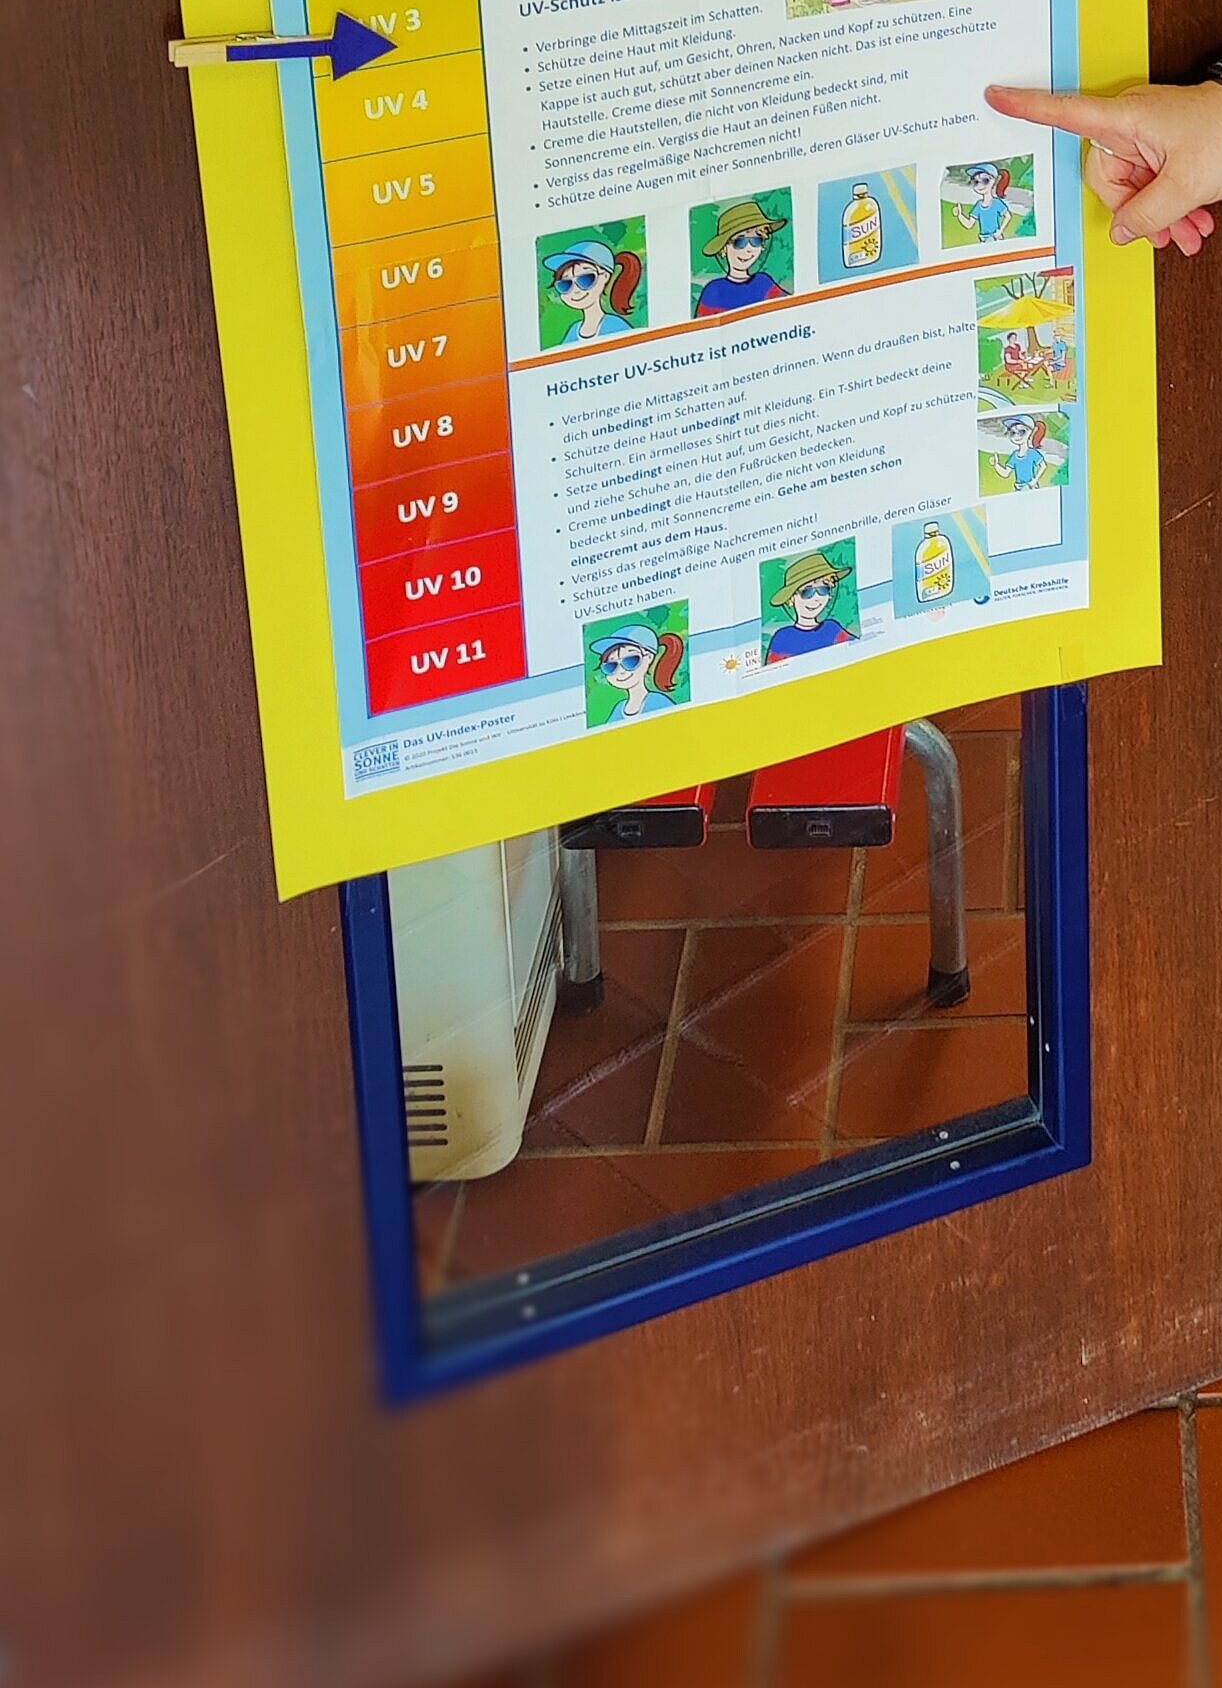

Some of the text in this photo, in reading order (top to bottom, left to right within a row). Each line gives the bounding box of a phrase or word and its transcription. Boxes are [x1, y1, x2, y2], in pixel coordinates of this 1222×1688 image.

[405, 8, 421, 31] 3
[535, 5, 762, 52] Verbringe die Mittagszeit im Schatten.
[537, 29, 735, 72] Schütze deine Haut mit Kleidung.
[538, 6, 972, 92] Setze einen Hut auf, um Gesicht, Ohren, Nacken und Kopf zu schützen. Eine
[365, 90, 428, 119] UV 4
[542, 70, 813, 131] Hautstelle. Creme diese mit Sonnencreme ein.
[544, 94, 880, 169] Sonnencreme ein. Vergiss die Haut an deinen Füßen nicht.
[545, 126, 800, 188] Vergiss das regelmäßige Nachcremen nicht!
[372, 173, 435, 204] UV 5
[851, 216, 877, 239] SUN
[380, 258, 444, 289] UV 6
[387, 336, 448, 368] UV 7
[546, 324, 815, 396] Höchster UV-Schutz ist notwendig.
[561, 320, 975, 425] Verbringe die Mittagszeit am besten drinnen. Wenn du draußen bist, halte
[392, 415, 454, 448] UV 8
[563, 390, 746, 443] dich unbedingt im Schatten auf.
[397, 491, 459, 523] UV 9
[569, 458, 901, 549] bedeckt sind, mit Sonnencreme ein. Gehe am besten schon
[570, 523, 727, 566] eingecremt aus dem Haus.
[570, 512, 817, 584] Vergiss das regelmäßige Nachcremen nicht!
[924, 553, 950, 575] SUN
[404, 566, 482, 601] UV 10
[574, 587, 675, 619] UV-Schutz haben.
[410, 639, 486, 674] UV 11
[388, 741, 399, 752] IN
[403, 739, 424, 749] Das
[426, 713, 516, 743] UV-Index-Poster
[355, 751, 399, 771] SONNE
